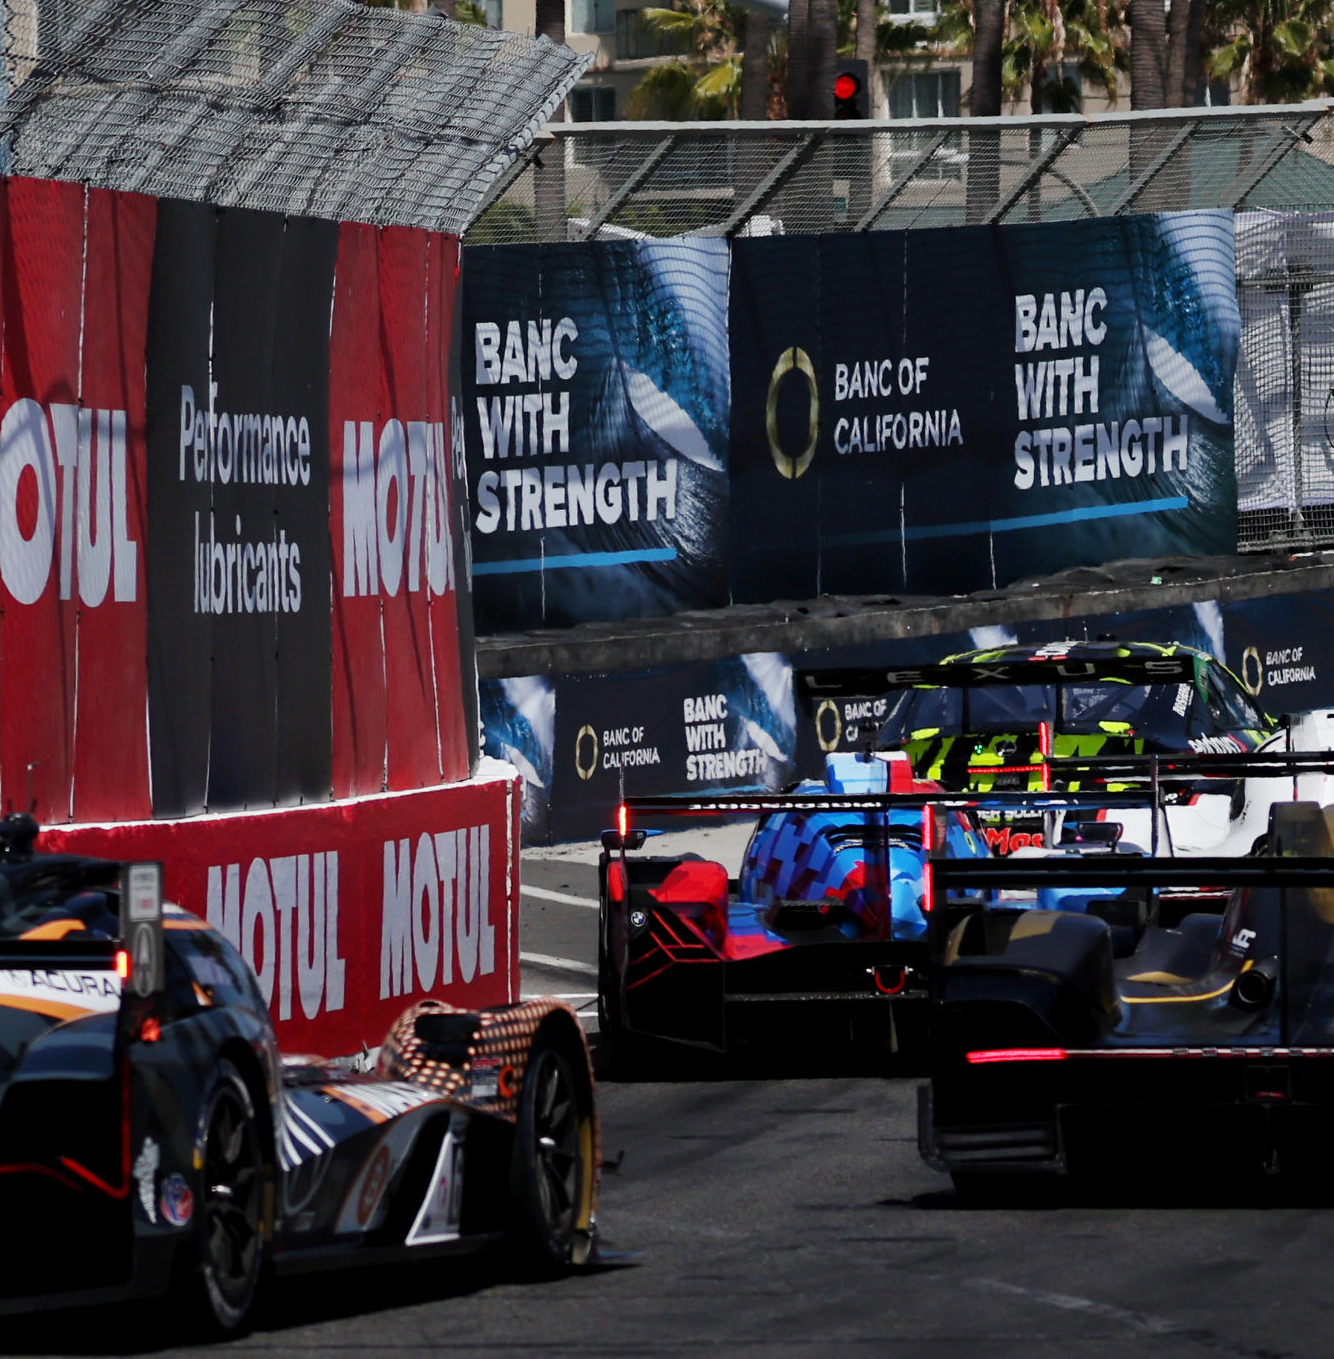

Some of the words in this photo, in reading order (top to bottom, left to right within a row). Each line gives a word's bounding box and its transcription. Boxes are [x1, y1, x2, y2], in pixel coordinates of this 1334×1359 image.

[1015, 287, 1108, 353] BANC
[475, 317, 578, 385] BANC
[835, 359, 892, 401] BANC
[898, 356, 929, 395] OF
[1015, 355, 1099, 420] WITH
[179, 382, 310, 486] Performance
[477, 391, 570, 459] WITH
[834, 409, 964, 455] CALIFORNIA
[1014, 414, 1188, 490] STRENGTH
[475, 458, 677, 534] STRENGTH
[194, 510, 302, 614] lubricants
[804, 660, 1183, 689] LEXUS
[1266, 648, 1291, 666] BANC
[1292, 647, 1303, 663] OF
[1267, 666, 1316, 687] CALIFORNIA
[683, 694, 728, 724] BANC
[845, 701, 872, 721] BANC
[873, 698, 887, 717] OF
[603, 728, 630, 747] BANC
[632, 726, 644, 743] OF
[603, 747, 660, 770] CALIFORNIA
[685, 723, 726, 752] WITH
[686, 748, 765, 782] STRENGTH
[380, 824, 495, 1001] MOTUL
[206, 850, 346, 1022] MOTUL
[29, 969, 122, 998] ACURA
